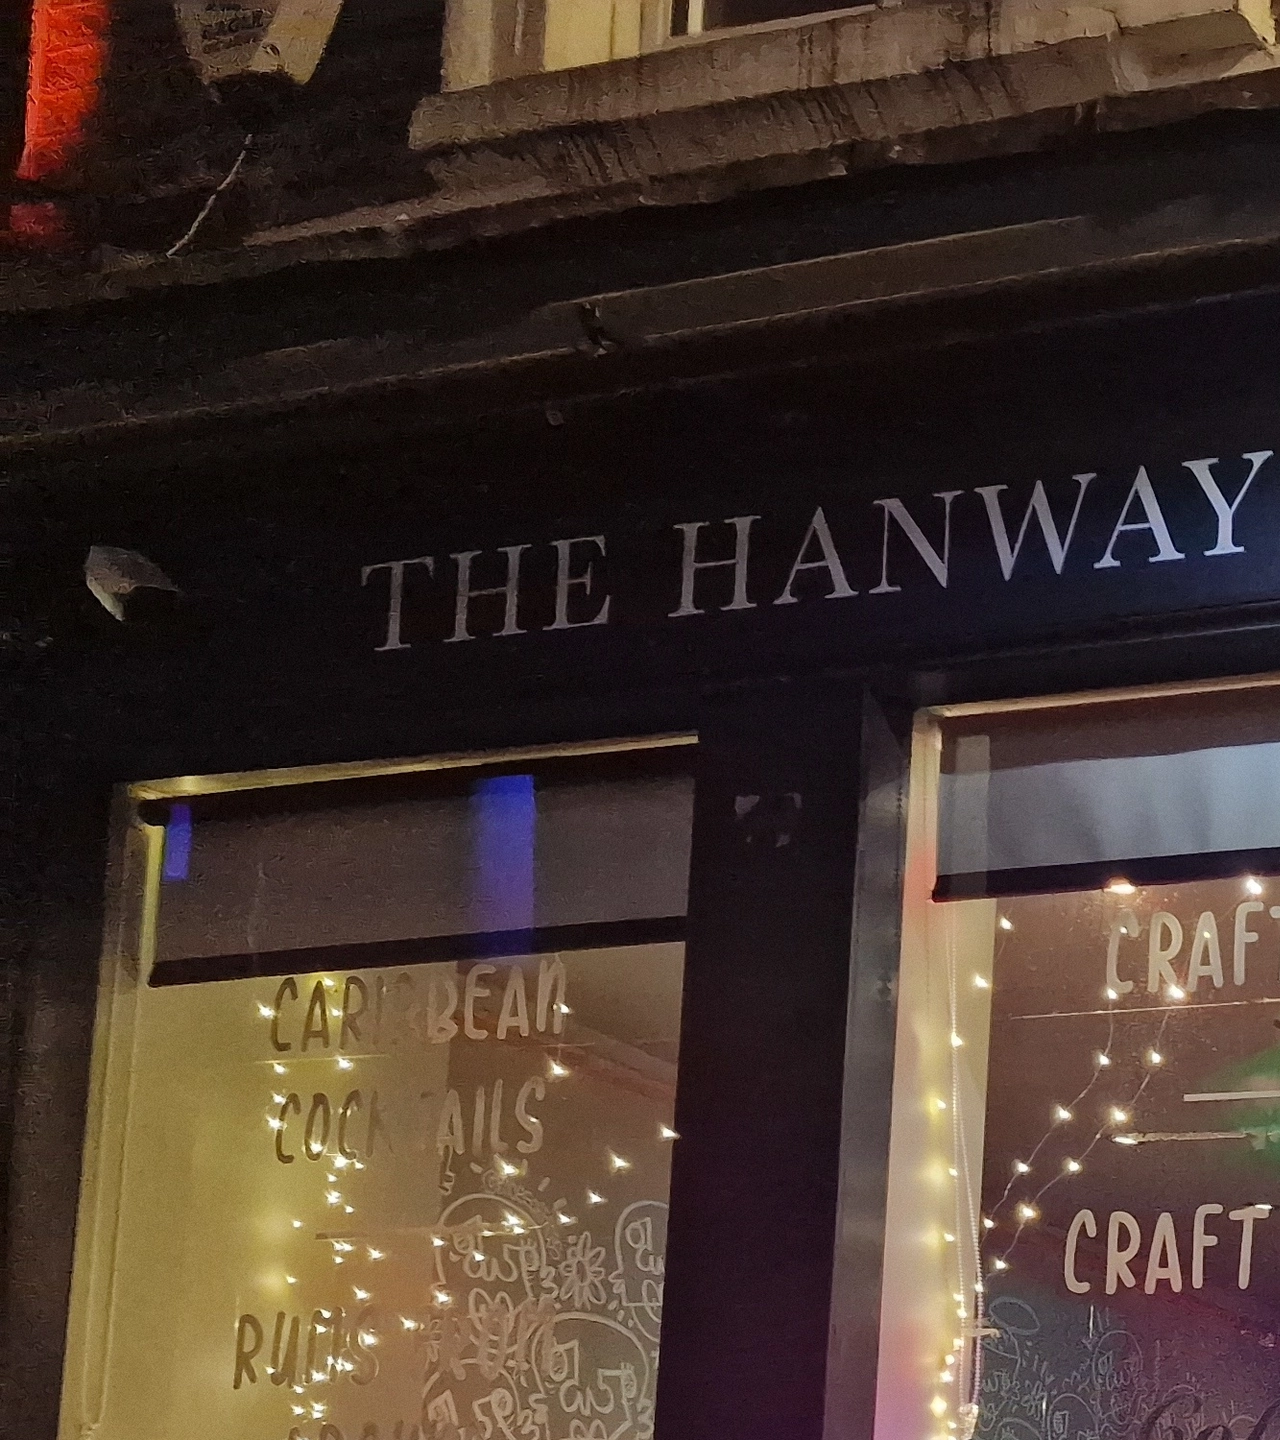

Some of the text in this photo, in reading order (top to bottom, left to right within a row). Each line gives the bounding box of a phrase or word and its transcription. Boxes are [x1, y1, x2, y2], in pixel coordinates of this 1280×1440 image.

[361, 449, 1274, 651] THE HANWAY
[270, 954, 567, 1052] CARIBEAN
[274, 1075, 546, 1164] COCKAILS
[1064, 1202, 1271, 1296] CRAFT
